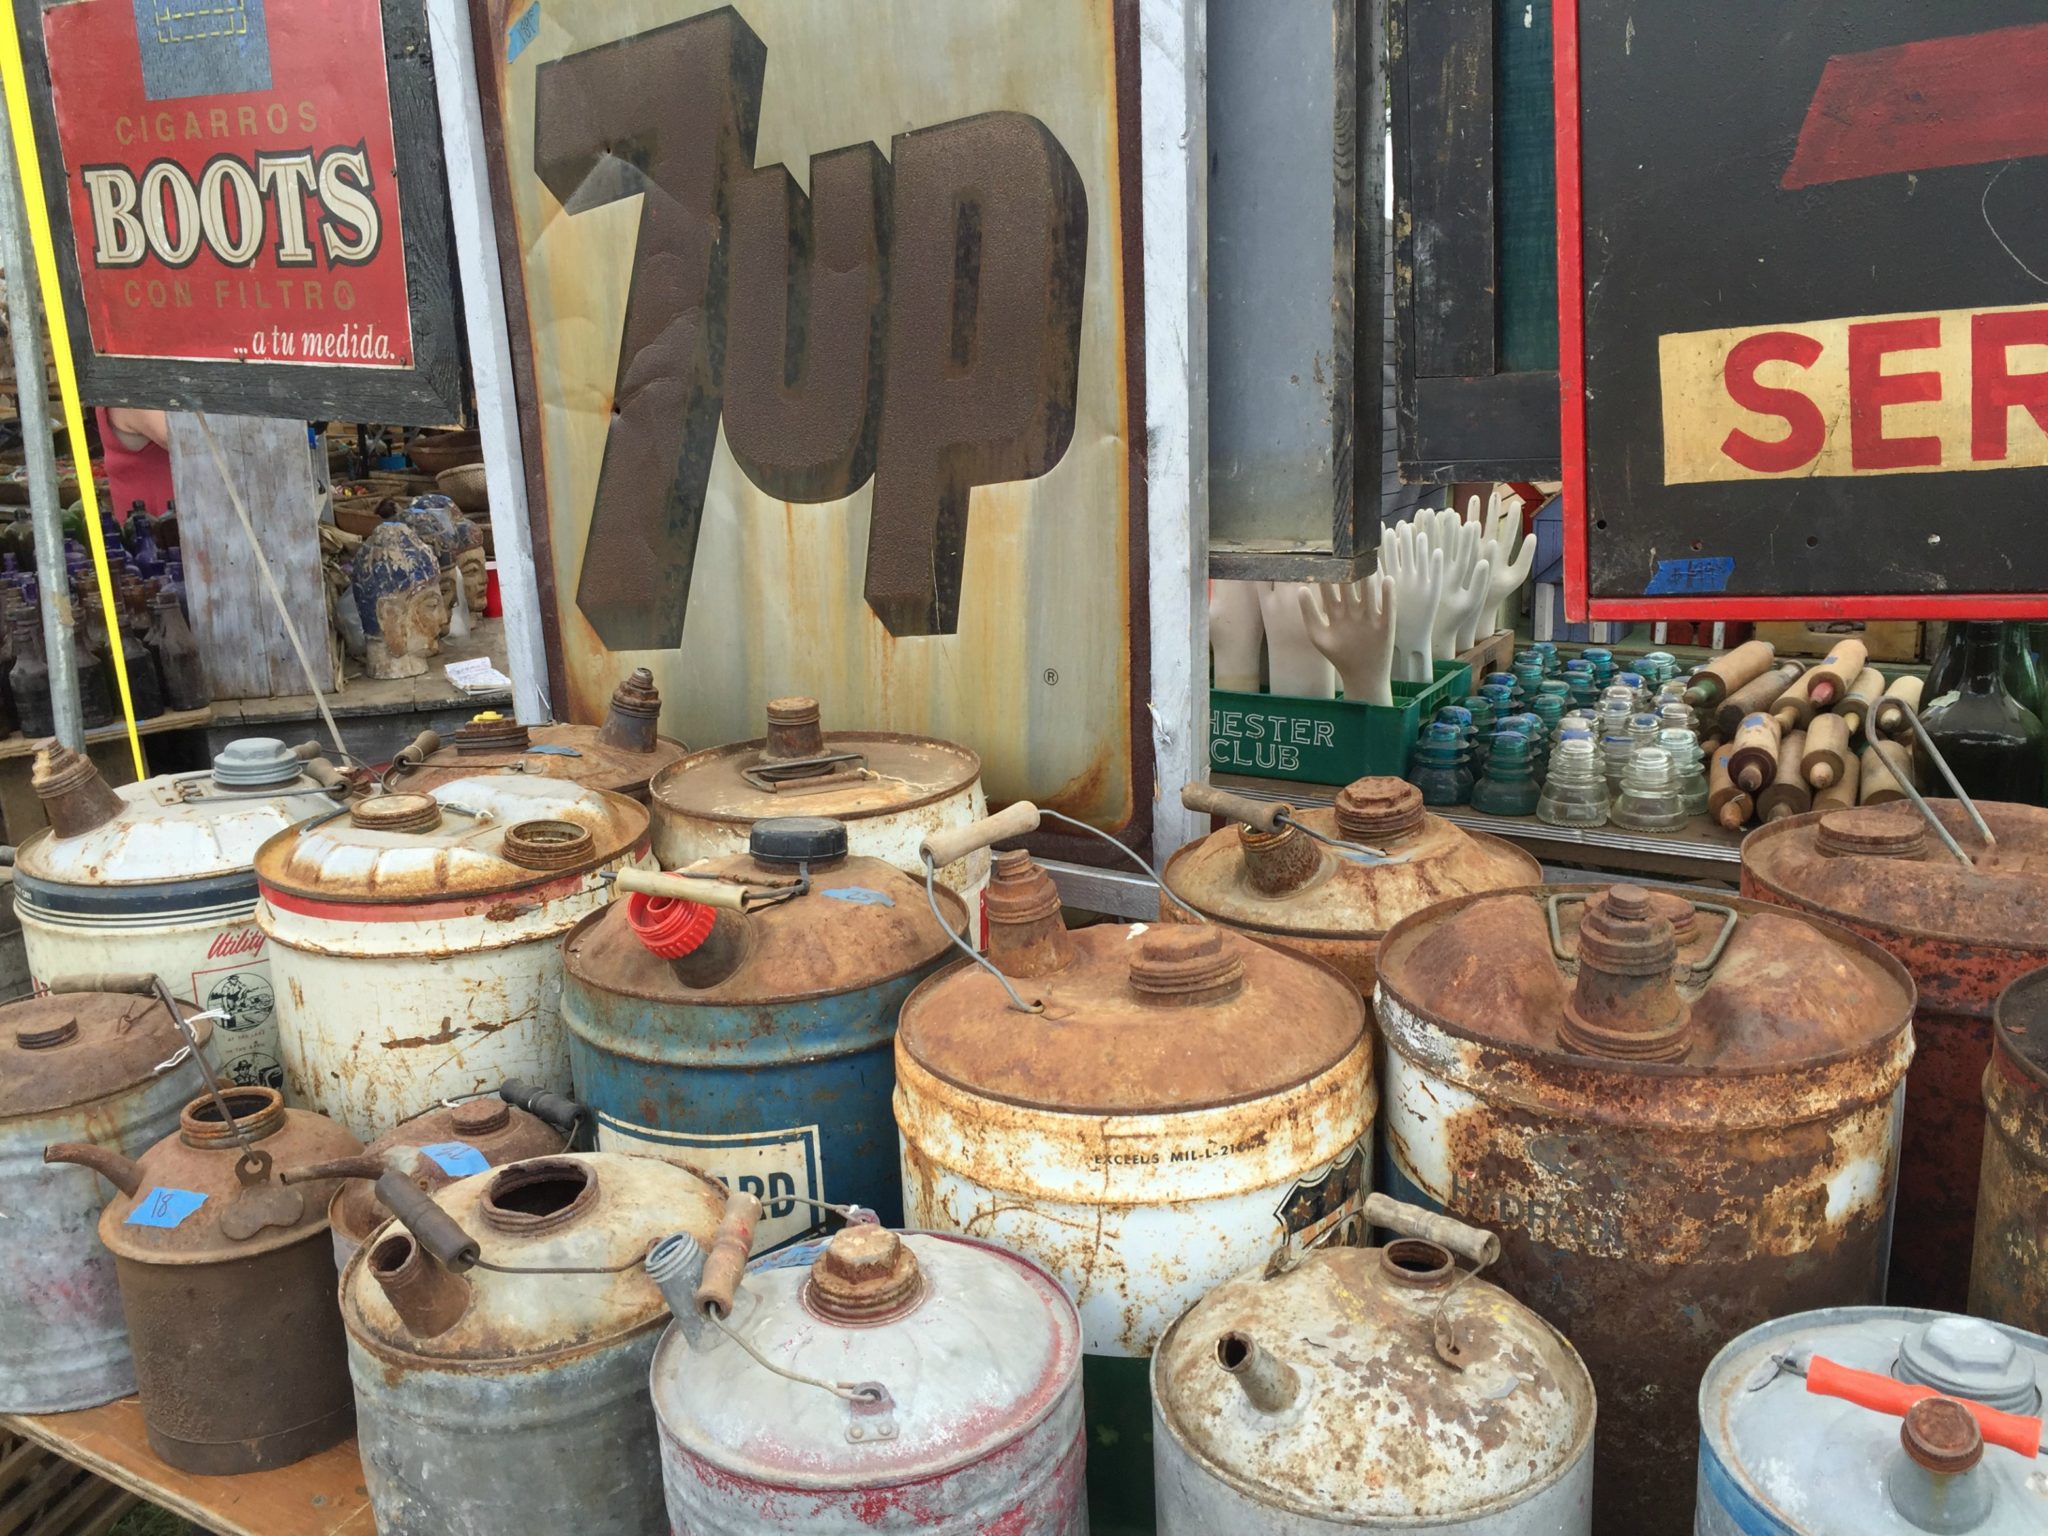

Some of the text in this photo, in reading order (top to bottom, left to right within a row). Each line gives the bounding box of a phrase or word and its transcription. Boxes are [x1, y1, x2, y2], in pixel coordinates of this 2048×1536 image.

[115, 101, 319, 146] CIGARROS
[80, 137, 382, 271] BOOTS
[124, 279, 356, 311] CON FILTRO
[271, 326, 296, 355] tu
[301, 323, 396, 360] medida.
[1721, 310, 2048, 473] SER
[1210, 738, 1300, 771] CLUB
[207, 928, 267, 960] Utility
[151, 1191, 174, 1218] 18
